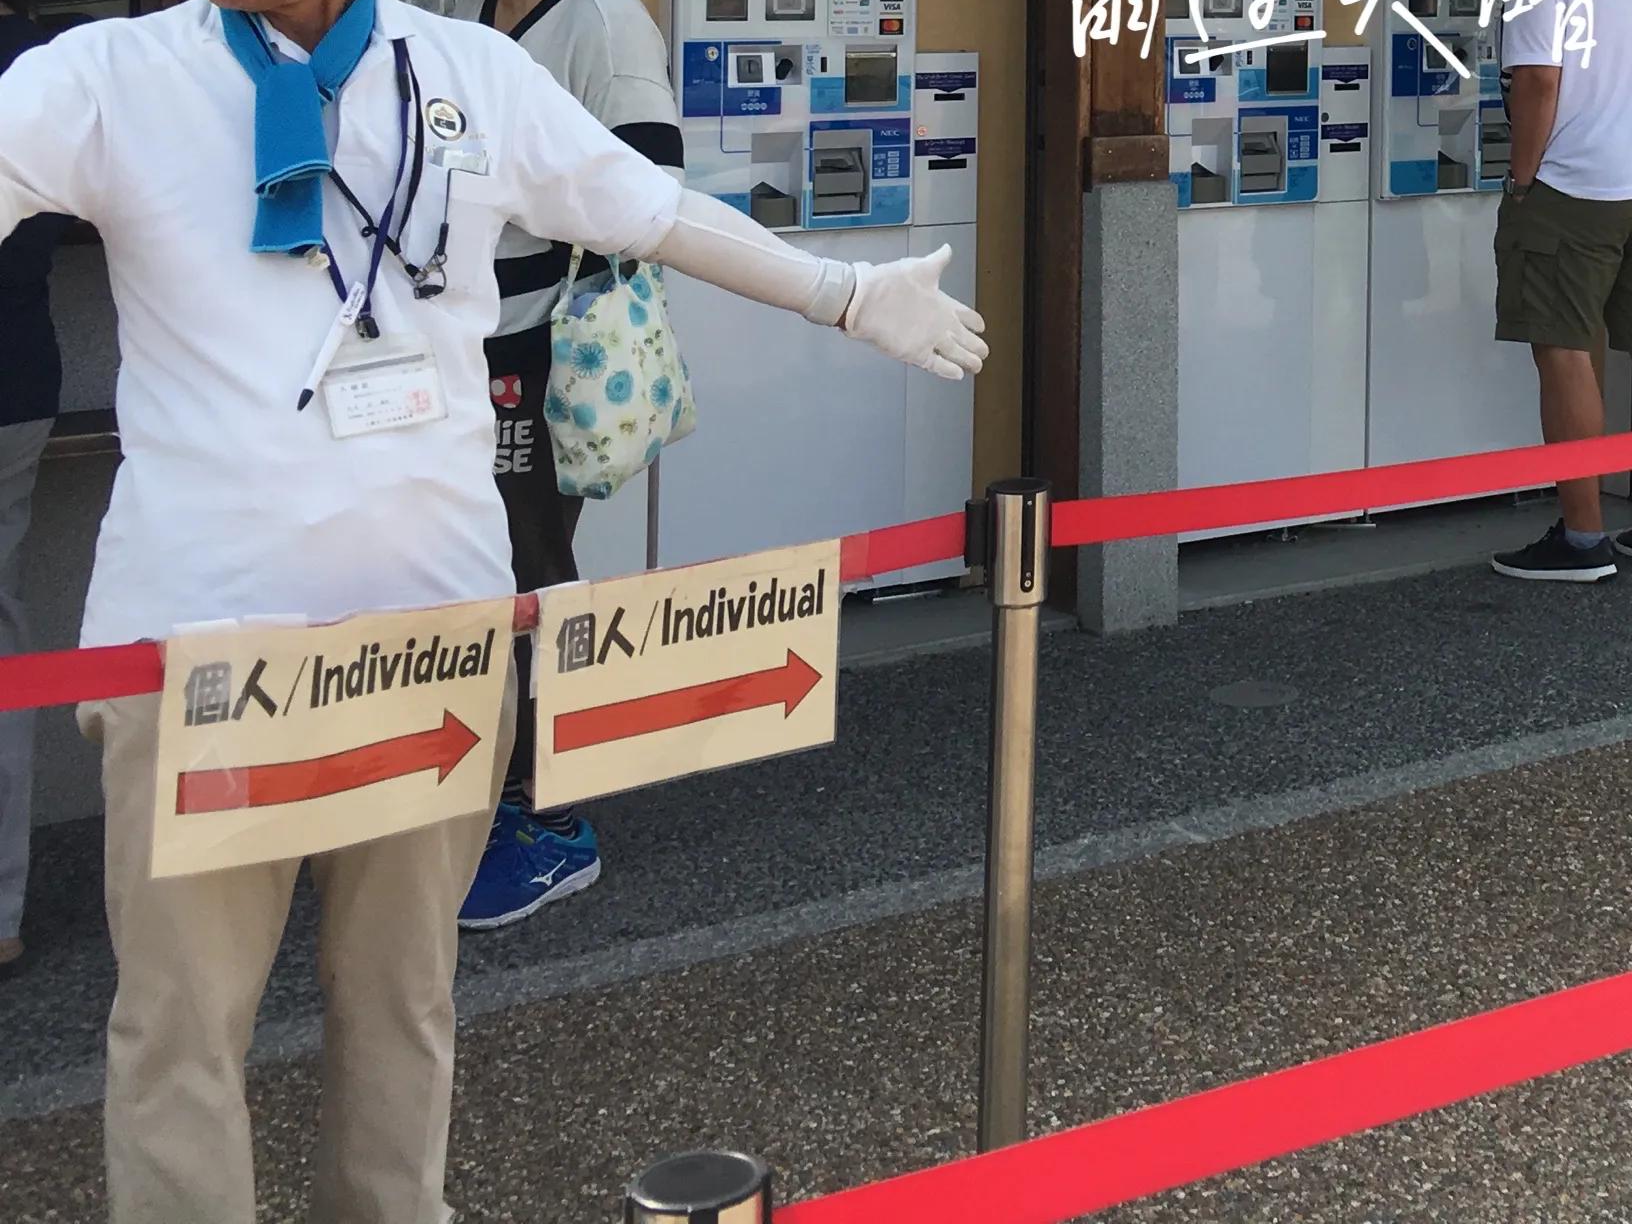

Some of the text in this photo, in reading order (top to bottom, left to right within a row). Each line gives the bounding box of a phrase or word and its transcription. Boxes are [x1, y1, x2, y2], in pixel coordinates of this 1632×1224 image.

[883, 3, 902, 11] VISA
[1297, 1, 1312, 10] VISA
[880, 129, 900, 137] NEC
